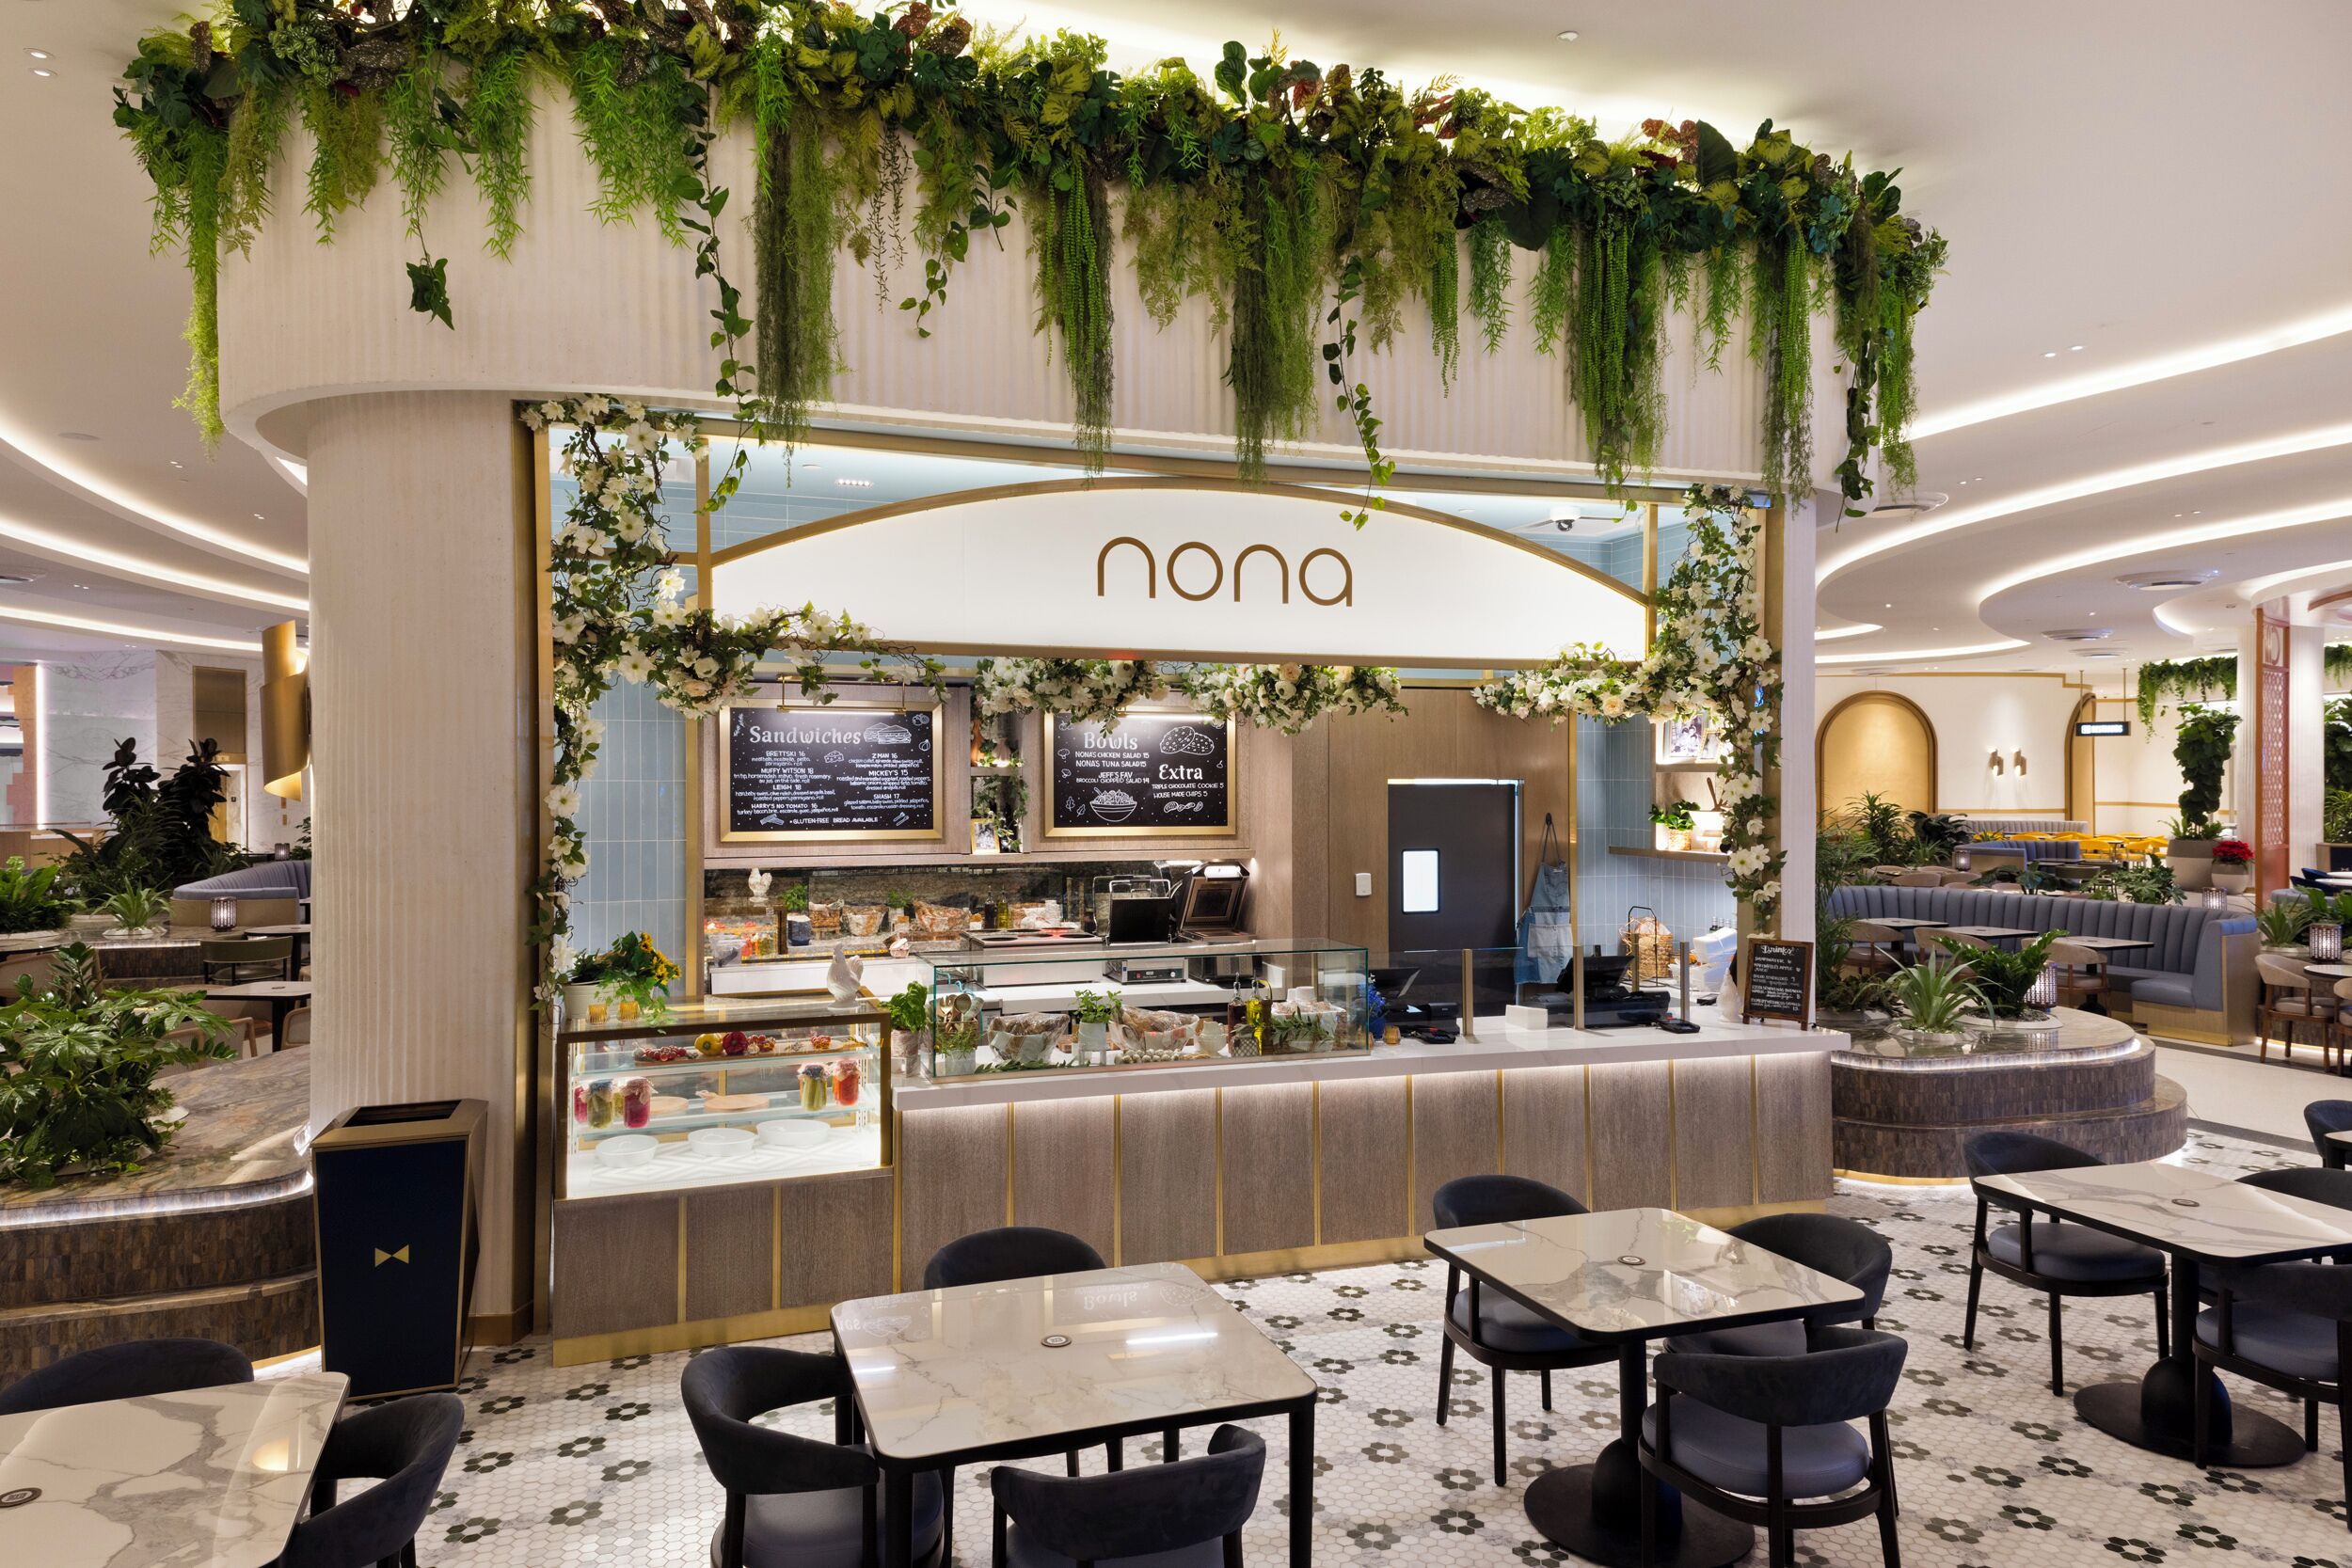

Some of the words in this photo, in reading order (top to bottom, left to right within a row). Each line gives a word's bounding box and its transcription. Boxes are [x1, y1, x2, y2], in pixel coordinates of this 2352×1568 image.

[1097, 536, 1353, 607] nona
[749, 725, 862, 744] Sandwiches
[1084, 730, 1138, 750] Bowls
[1158, 764, 1203, 780] Extra
[1761, 945, 1794, 956] Drinks
